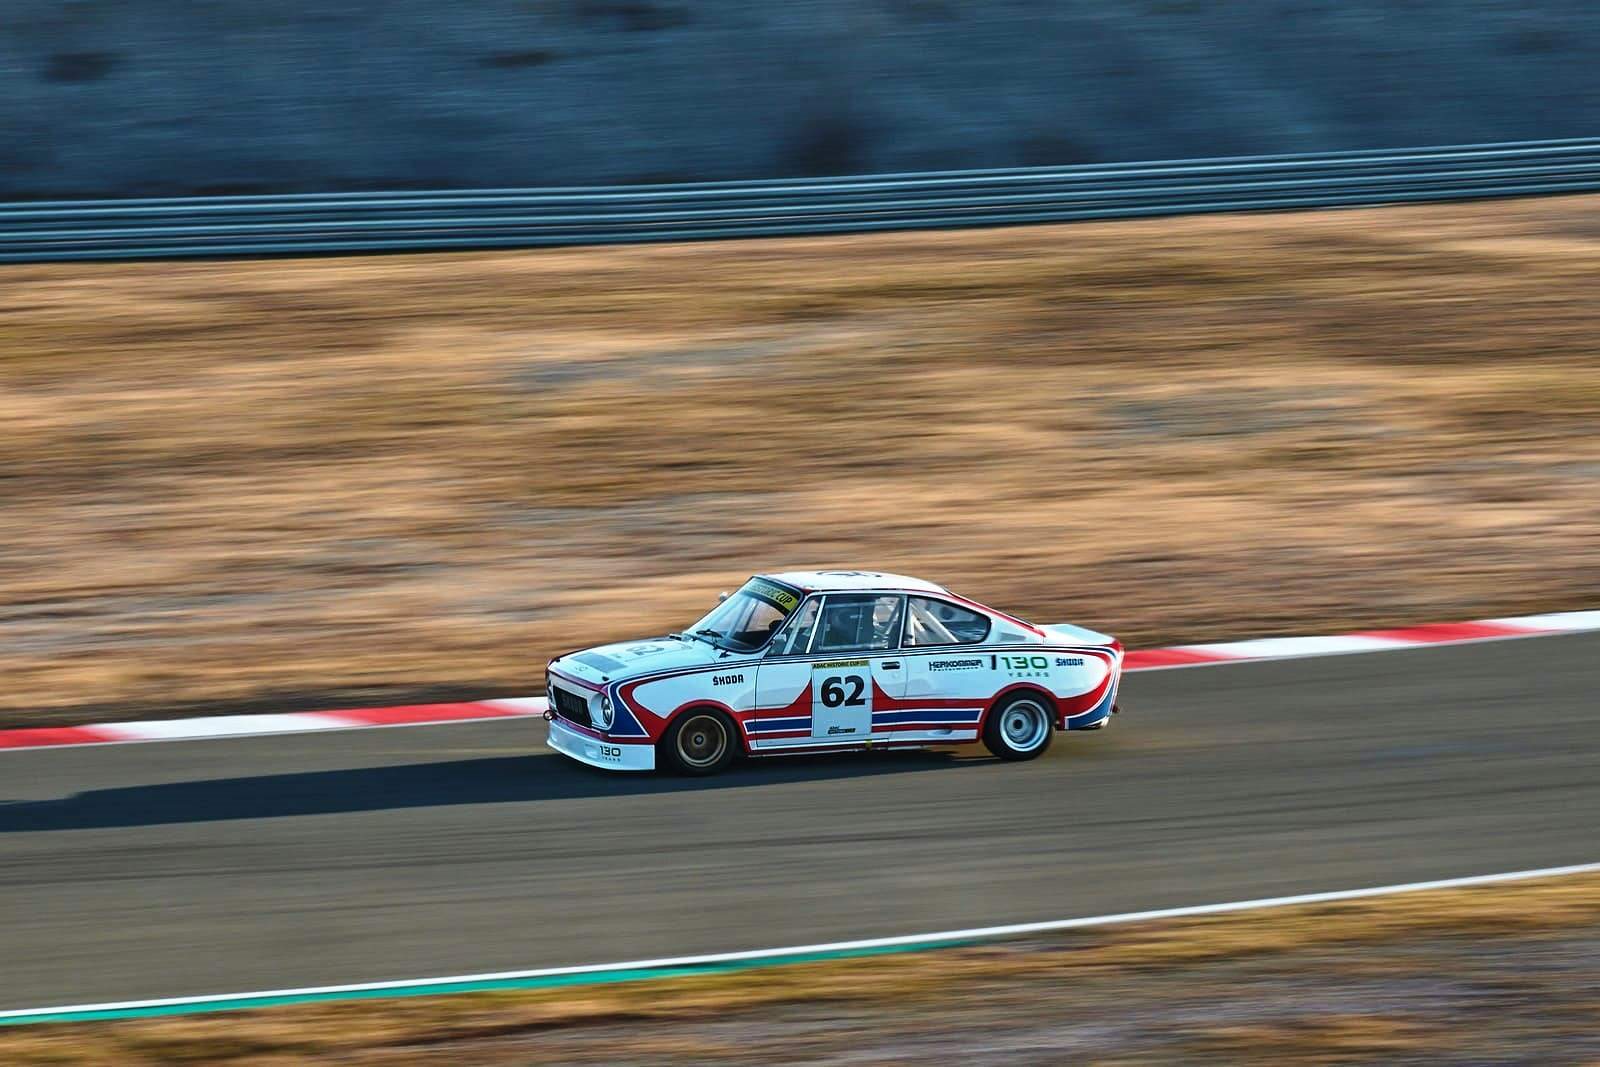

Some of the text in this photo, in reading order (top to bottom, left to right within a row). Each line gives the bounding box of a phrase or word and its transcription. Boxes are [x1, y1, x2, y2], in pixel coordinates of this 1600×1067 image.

[776, 592, 793, 605] CUP
[1001, 656, 1048, 669] 130
[821, 675, 865, 708] 62
[599, 745, 621, 757] 130
